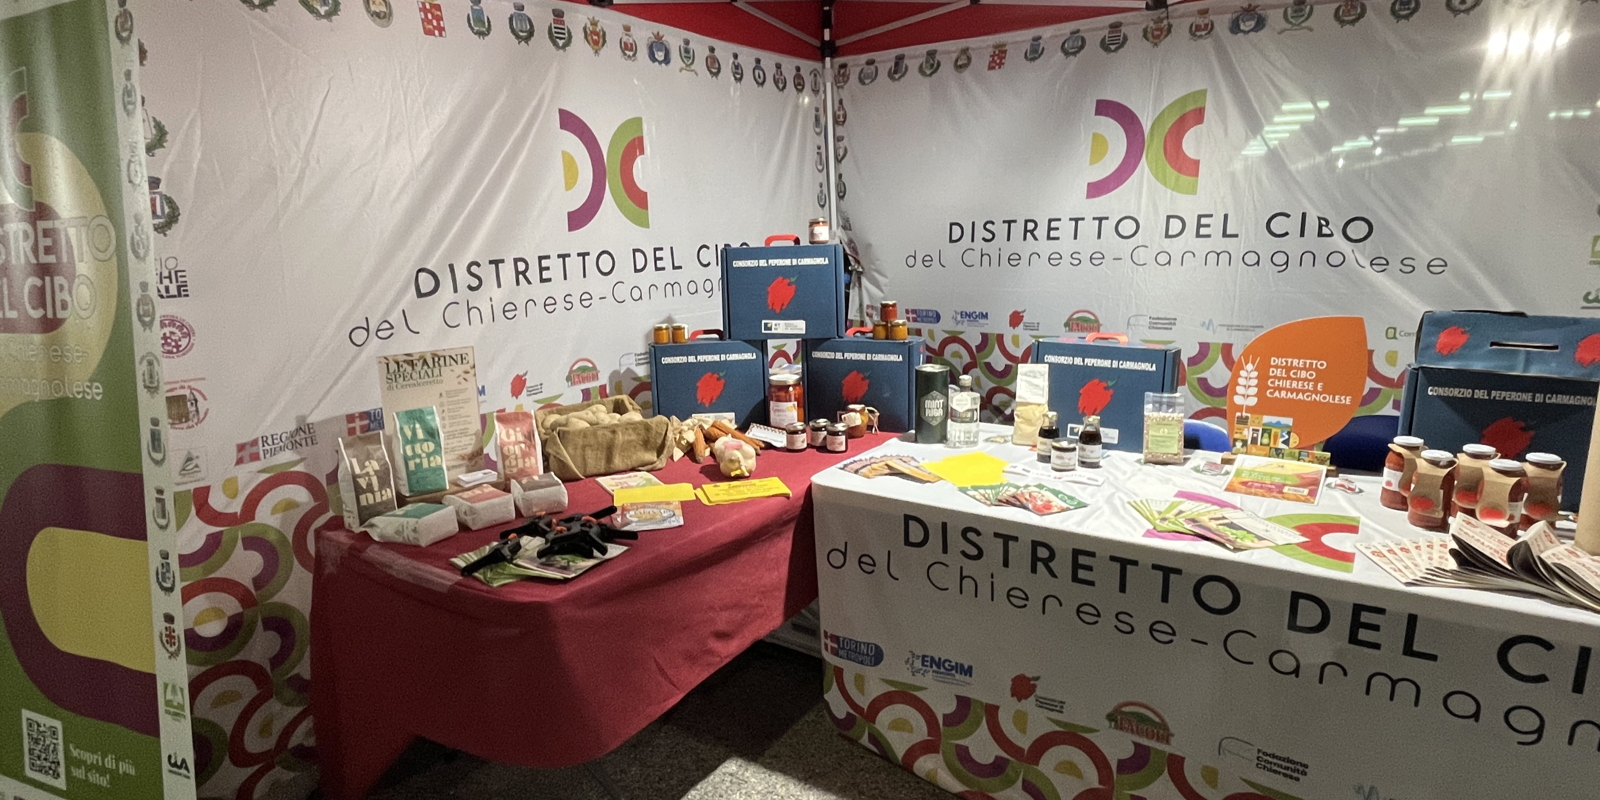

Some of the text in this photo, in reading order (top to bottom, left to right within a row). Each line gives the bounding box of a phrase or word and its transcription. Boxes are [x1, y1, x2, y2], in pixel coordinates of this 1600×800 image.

[948, 211, 1374, 244] DISTRETTO DEL CIBO
[414, 240, 750, 299] DISTRETTO DEL CI
[733, 257, 829, 268] CONSORZIO DEL PEPERONE DI CARMAGNOLA
[905, 243, 1449, 276] del Chierese-Carmagnolese
[23, 273, 97, 320] CIBO
[960, 310, 989, 320] ENGIM
[348, 308, 420, 347] del
[385, 352, 470, 375] LE FARINE
[661, 355, 687, 364] CONSORZIO
[688, 355, 697, 363] DEL
[697, 354, 720, 362] PEPERONE
[726, 352, 757, 361] CARMAGNOLA
[812, 351, 903, 362] CONSORZIO DEL PEPERONE DI CARMAGNOLA
[1044, 354, 1157, 372] CONSORZIO DEL PEPERONE DI CARMAGNOLA
[1270, 356, 1328, 370] DISTRETTO
[385, 367, 443, 385] SPECIALI
[1269, 367, 1317, 380] DEL CIBO
[386, 383, 395, 391] di
[1267, 378, 1323, 391] CHIERESE E
[1427, 386, 1473, 398] CONSORZIO
[1474, 389, 1490, 400] DEL
[1490, 391, 1533, 403] PEPERONE
[1535, 394, 1544, 403] DI
[1266, 388, 1352, 405] CARMAGNOLESE
[260, 422, 316, 448] REGIONE
[262, 434, 318, 459] PIEMONTE
[351, 457, 381, 476] La
[407, 453, 442, 472] ria
[359, 487, 393, 507] nia
[903, 513, 1592, 695] DISTRETTO DEL CI
[826, 541, 1600, 753] del Chierese-Carmagn
[839, 637, 876, 656] TORINO
[838, 649, 875, 667] METROPOLI
[921, 654, 973, 679] ENGIM
[69, 743, 135, 776] Scopri di più
[1256, 755, 1308, 777] Comunità
[1257, 748, 1309, 770] Fodazione
[71, 765, 110, 788] sul sito!
[1255, 762, 1301, 782] Chierese
